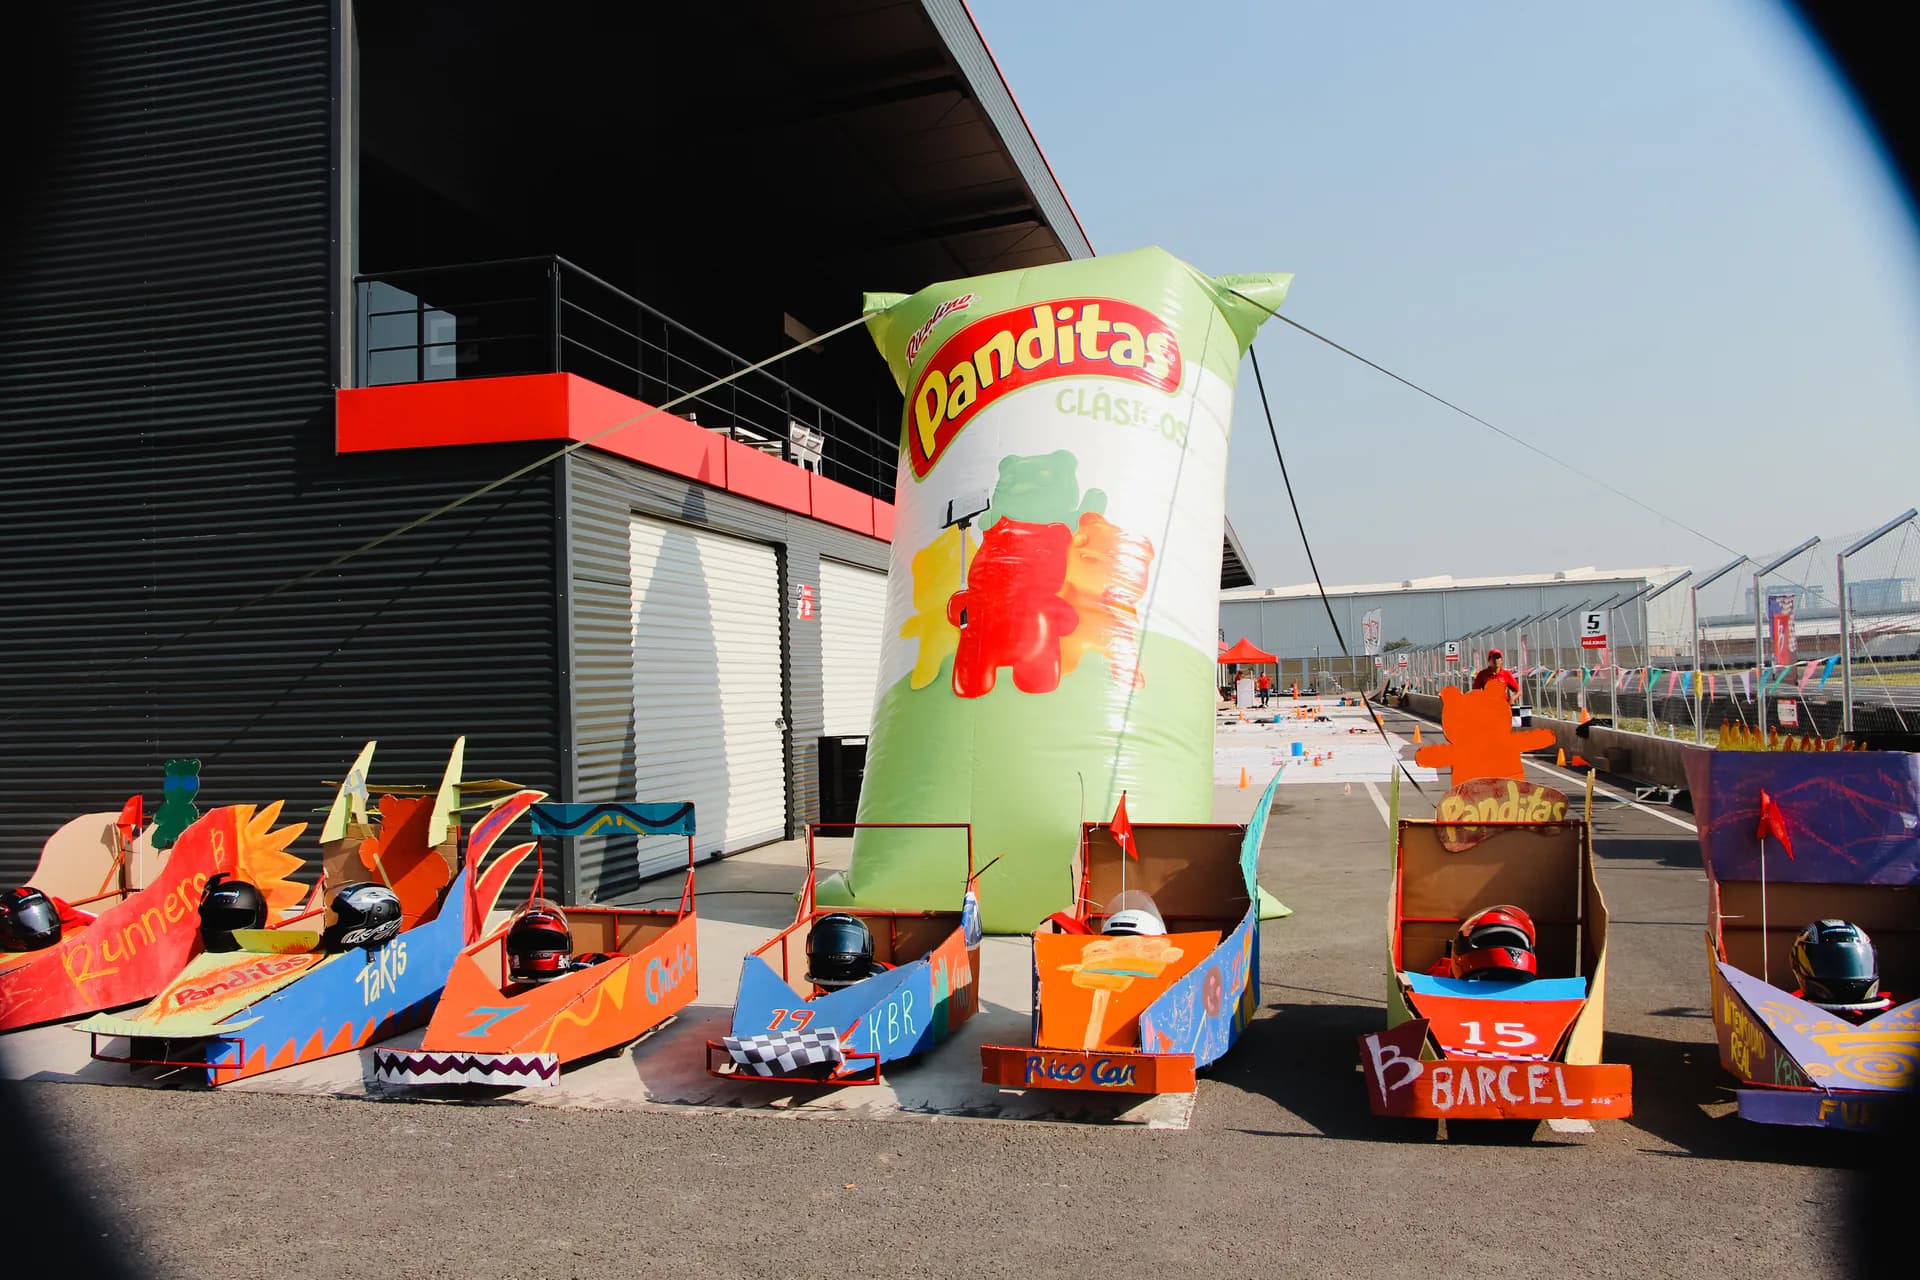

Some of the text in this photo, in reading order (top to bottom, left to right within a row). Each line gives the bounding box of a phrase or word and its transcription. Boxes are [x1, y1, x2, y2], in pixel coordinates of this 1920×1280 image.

[914, 303, 1174, 461] Panditas
[1587, 614, 1600, 630] 5
[1441, 780, 1565, 842] Panditas
[175, 954, 311, 1007] Panditas
[766, 1009, 816, 1032] 19
[869, 990, 916, 1053] KBR
[1460, 1021, 1538, 1047] 15
[1024, 1055, 1137, 1087] Rico Car
[1431, 1063, 1584, 1111] BARCEL
